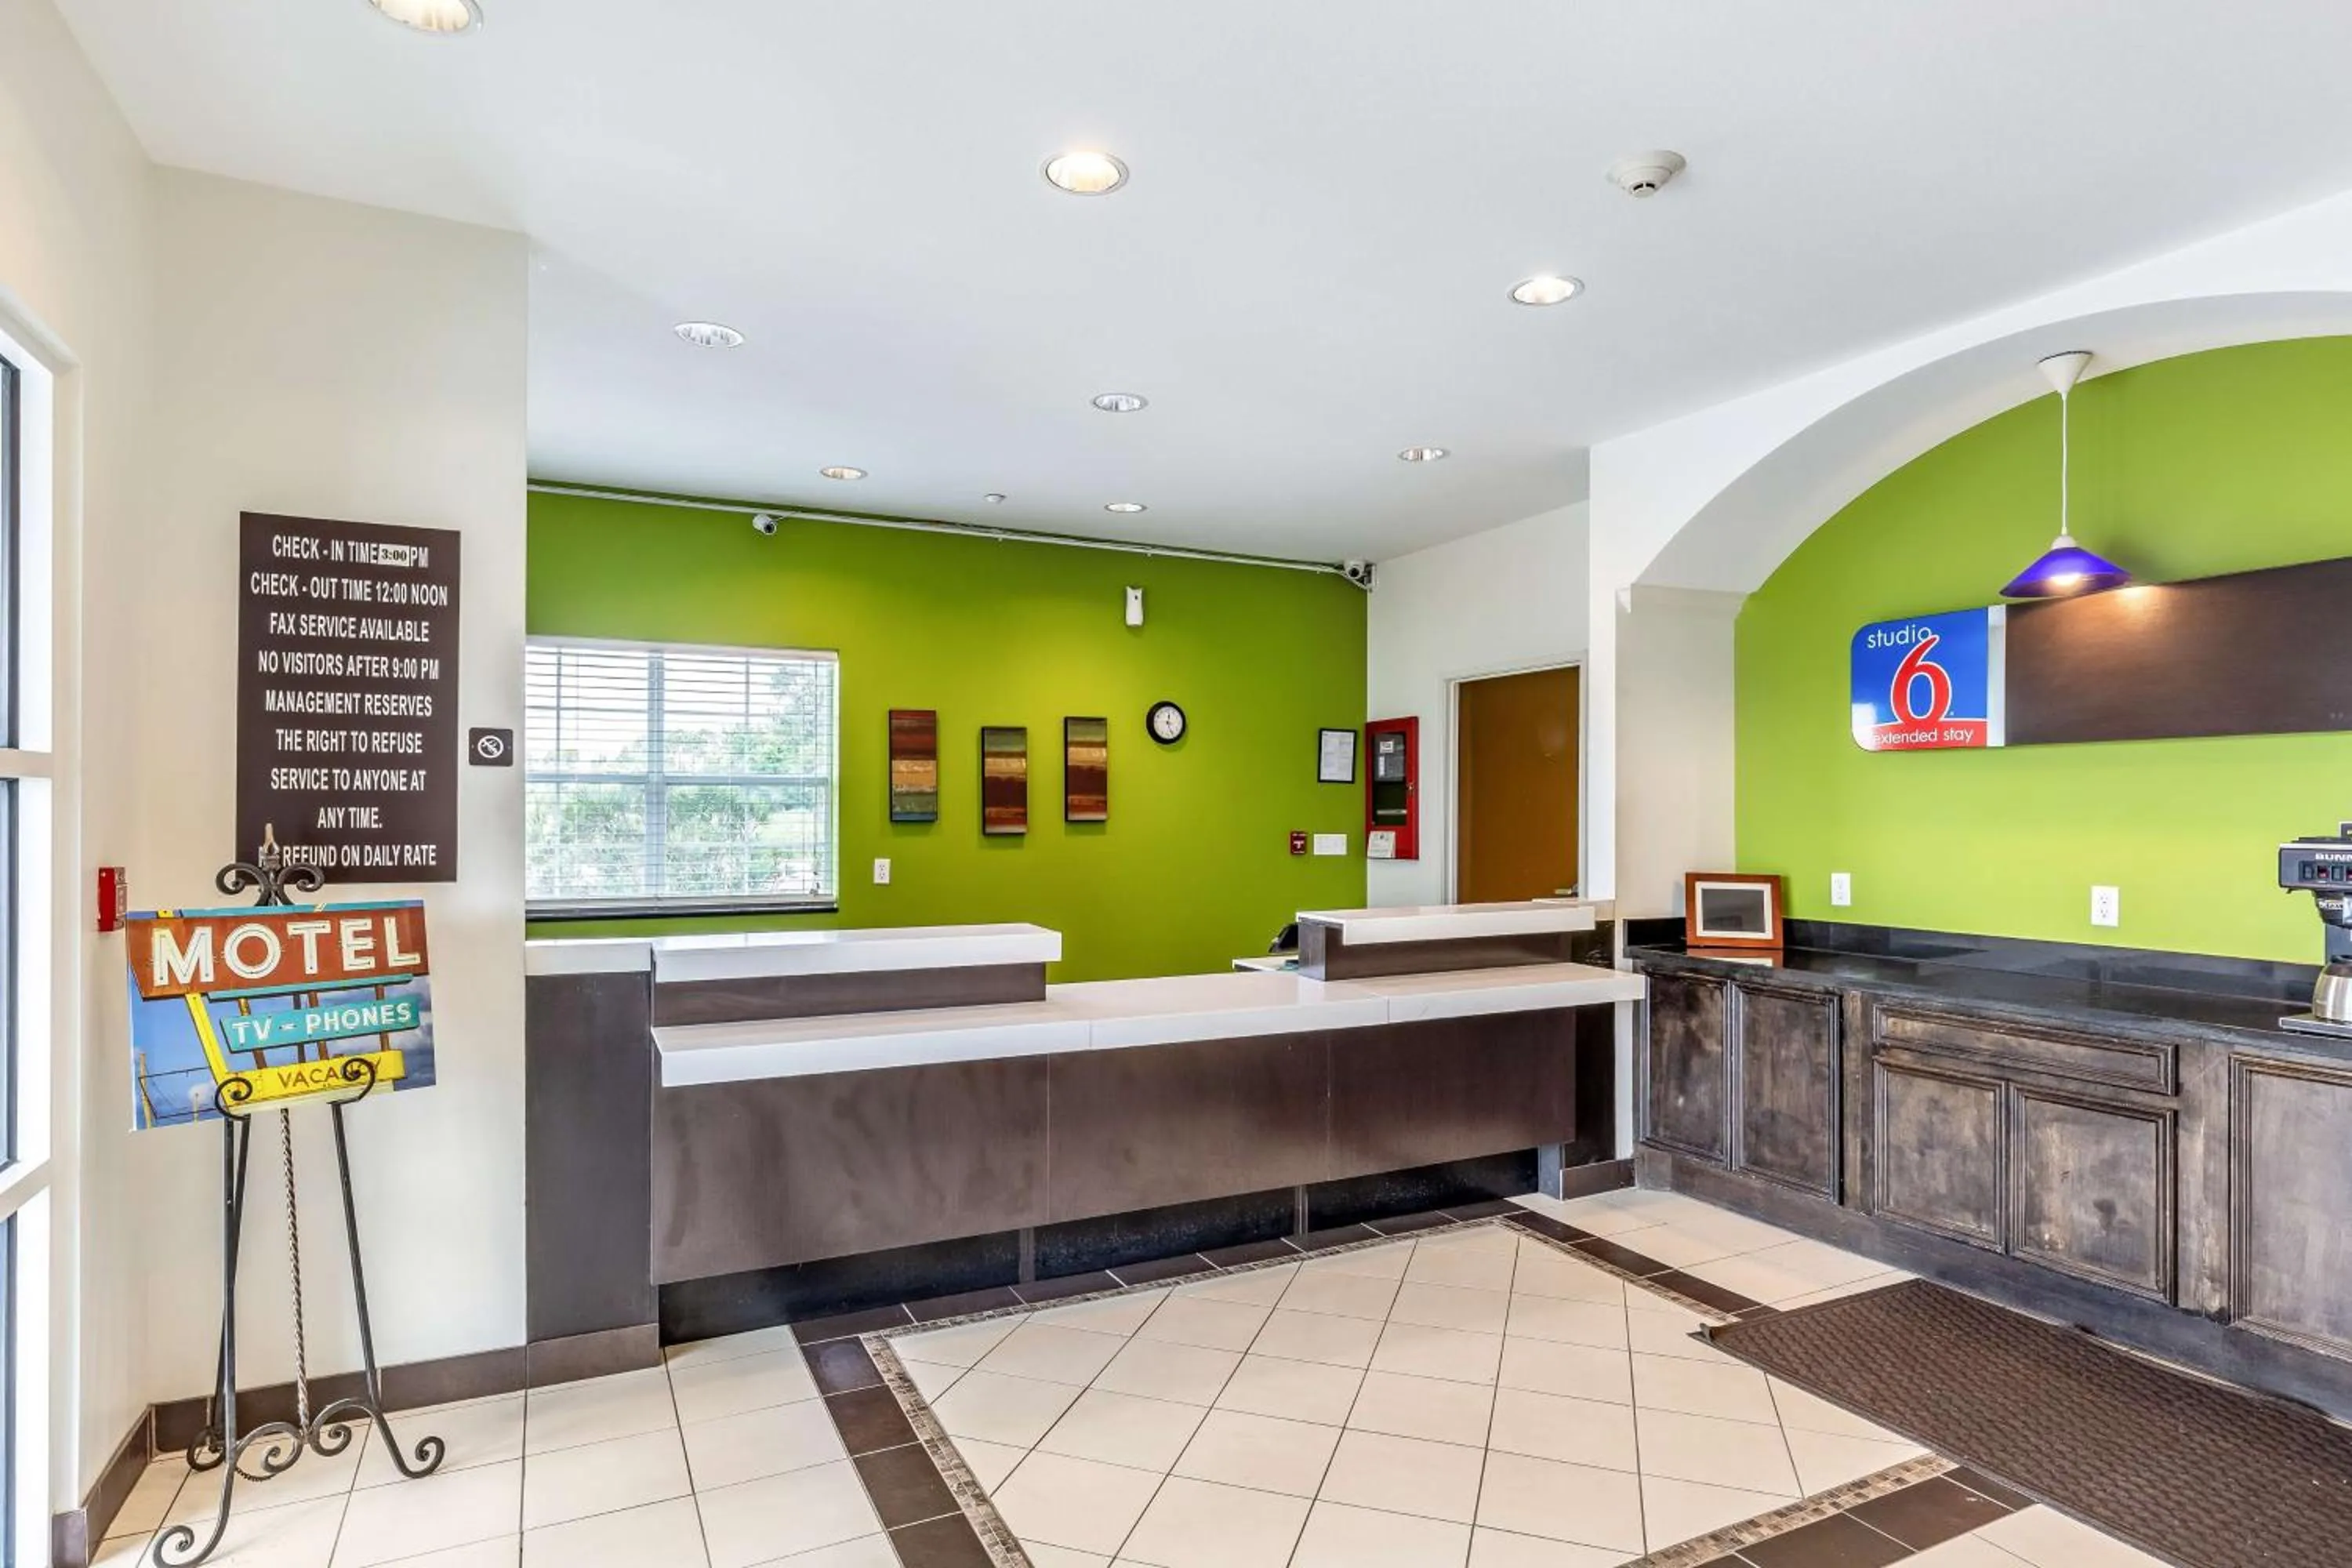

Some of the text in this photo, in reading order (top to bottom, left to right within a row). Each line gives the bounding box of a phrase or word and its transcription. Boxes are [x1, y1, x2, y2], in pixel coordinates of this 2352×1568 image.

[347, 541, 379, 564] TIME
[381, 548, 407, 562] 3:00
[411, 546, 429, 568] PM
[342, 579, 372, 601] TIME
[376, 582, 407, 604] 12:00
[412, 584, 448, 606] NOON
[270, 612, 430, 642] FAX SERVICE AVAILABLE
[1867, 624, 1932, 648] studio
[258, 650, 439, 680] NO VISITORS AFTER 9:00 PM
[1890, 634, 1952, 723] 6
[266, 689, 432, 717] MANAGEMENT RESERVES
[276, 728, 423, 753] THE RIGHT TO REFUSE
[1874, 728, 1973, 744] extended stay
[270, 768, 426, 791] SERVICE TO ANYONE AT
[317, 807, 383, 829] ANY TIME.
[283, 845, 336, 866] REFUND
[341, 845, 361, 866] ON
[363, 845, 400, 866] DAILY
[404, 844, 437, 866] RATE
[153, 917, 421, 986] MOTEL
[232, 1018, 272, 1046] TV
[306, 1002, 412, 1038] PHONES
